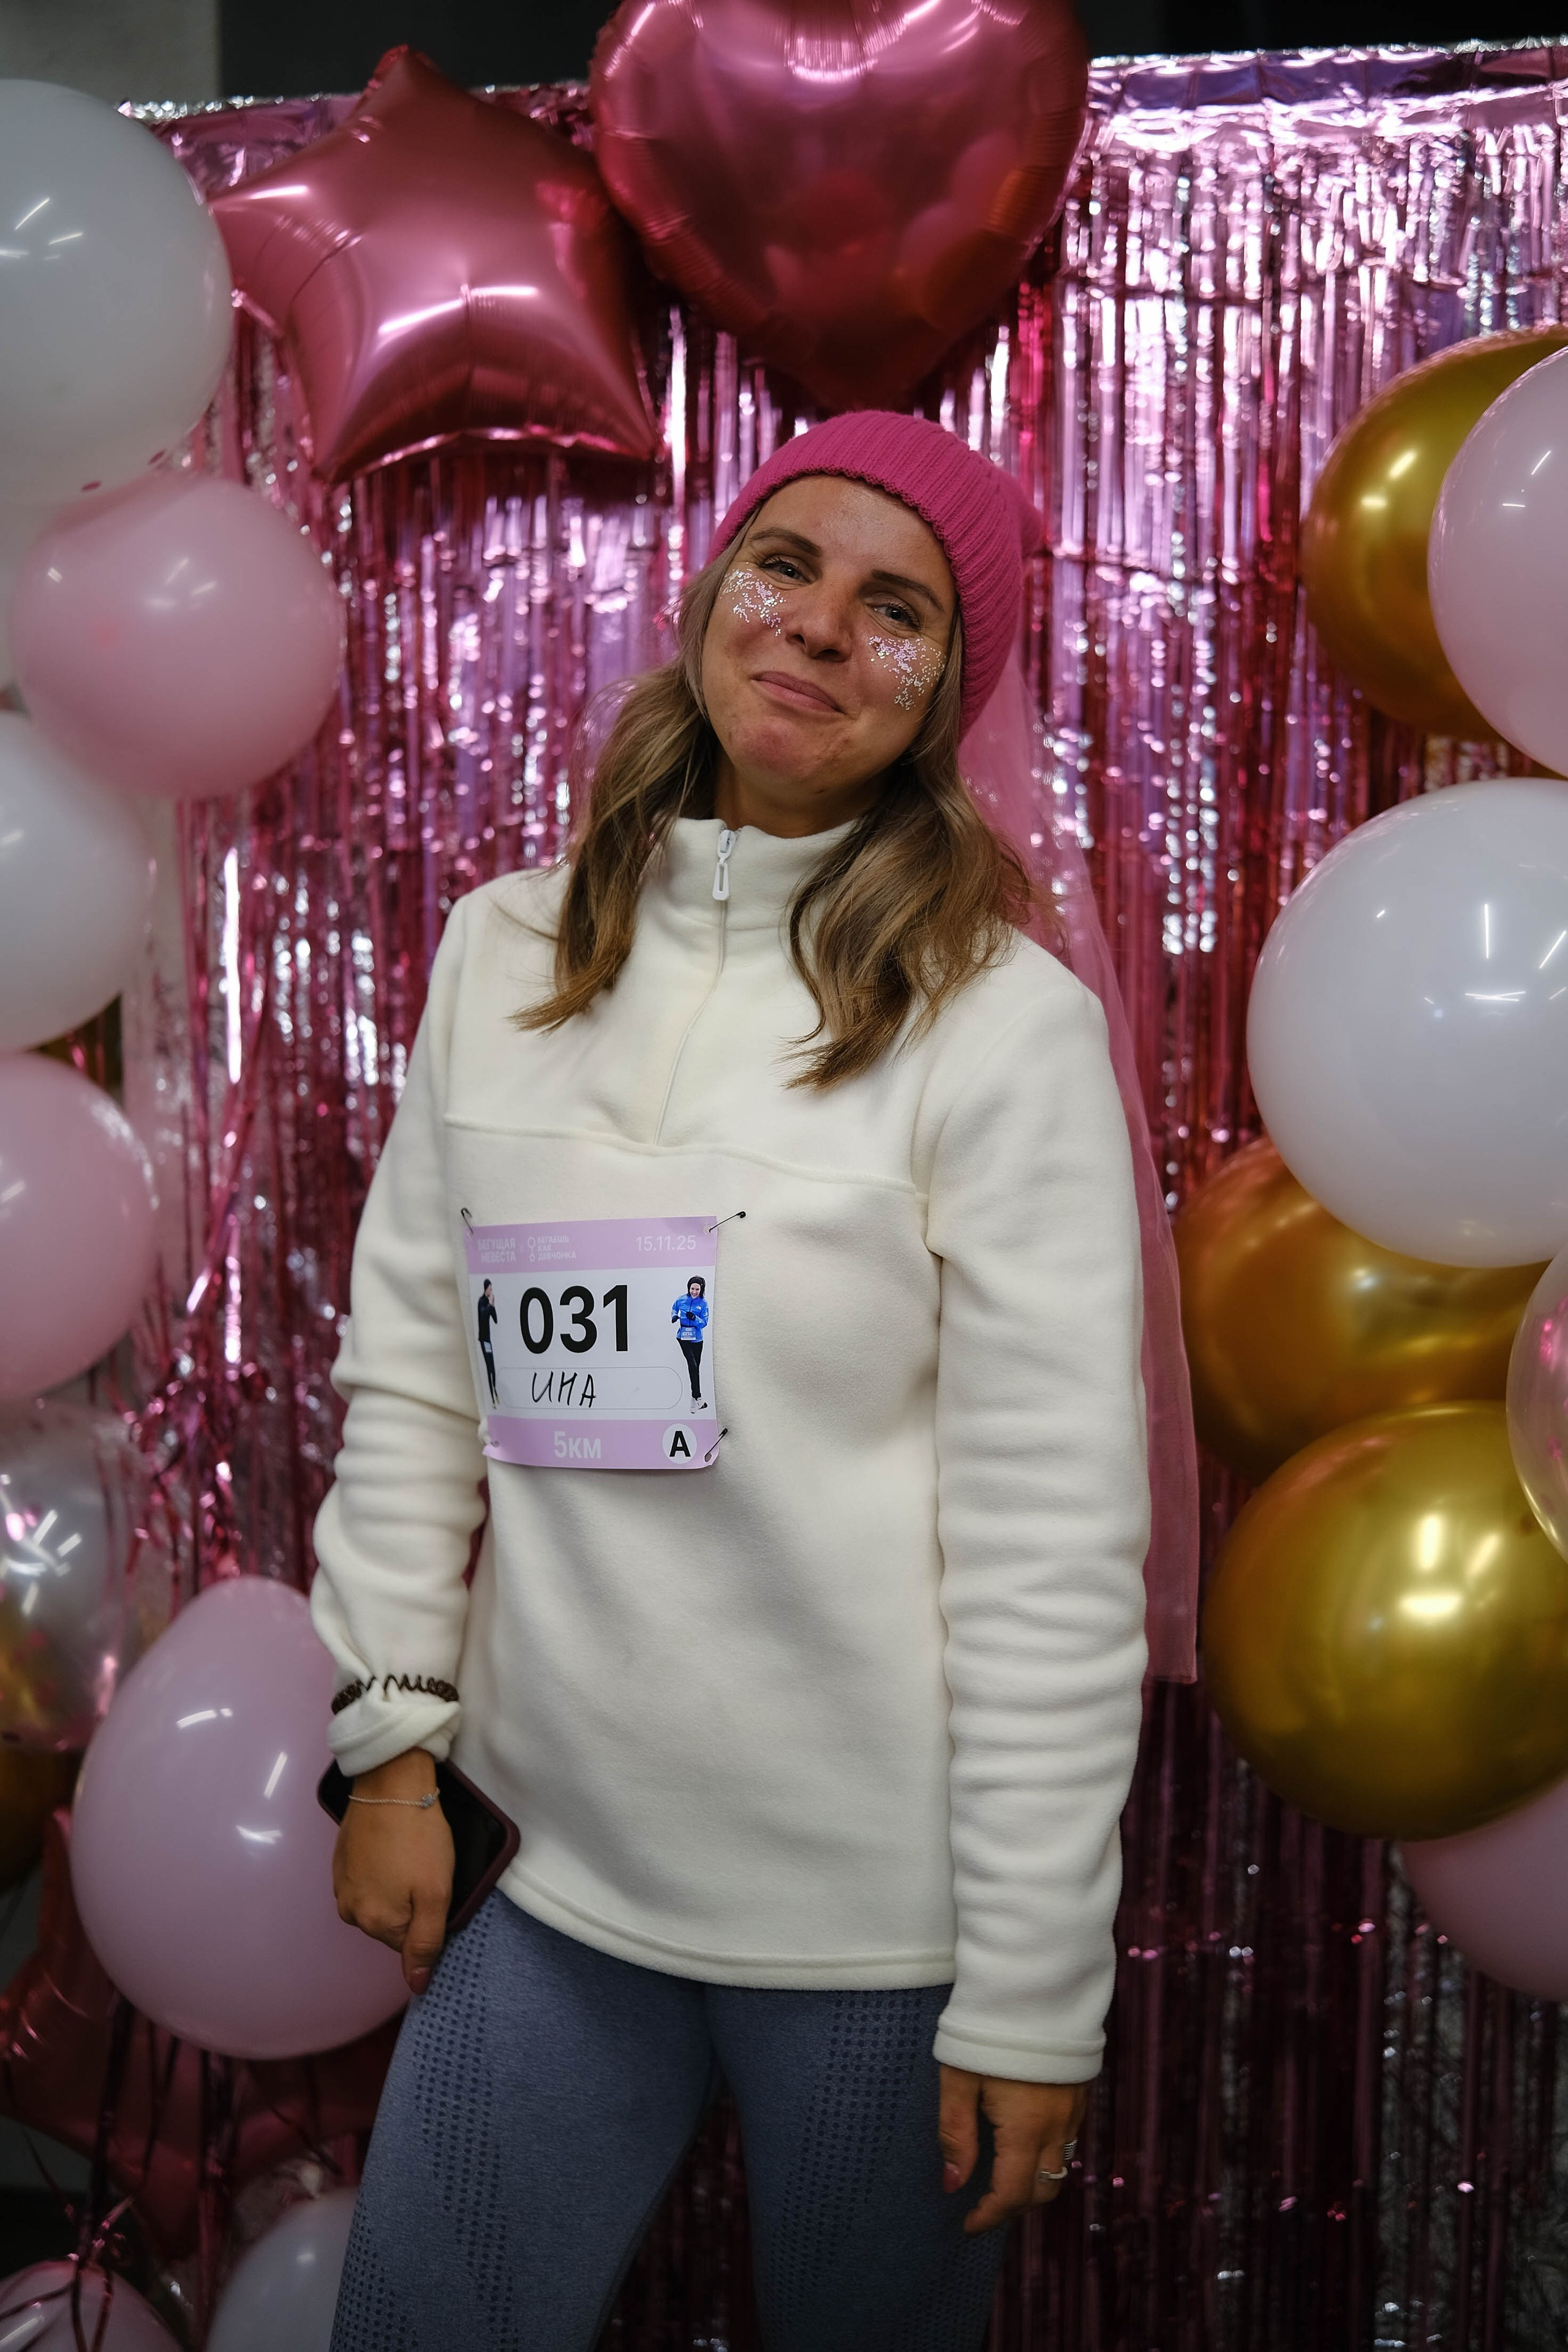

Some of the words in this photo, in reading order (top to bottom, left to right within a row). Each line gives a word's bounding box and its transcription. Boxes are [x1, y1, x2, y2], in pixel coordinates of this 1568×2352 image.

[477, 1237, 516, 1251] БЕГУЩАЯ
[636, 1235, 696, 1251] 15.11.25
[481, 1251, 516, 1263] НЕВЕСТА
[538, 1251, 577, 1262] ДЕВЧОНКА
[519, 1284, 628, 1354] 031
